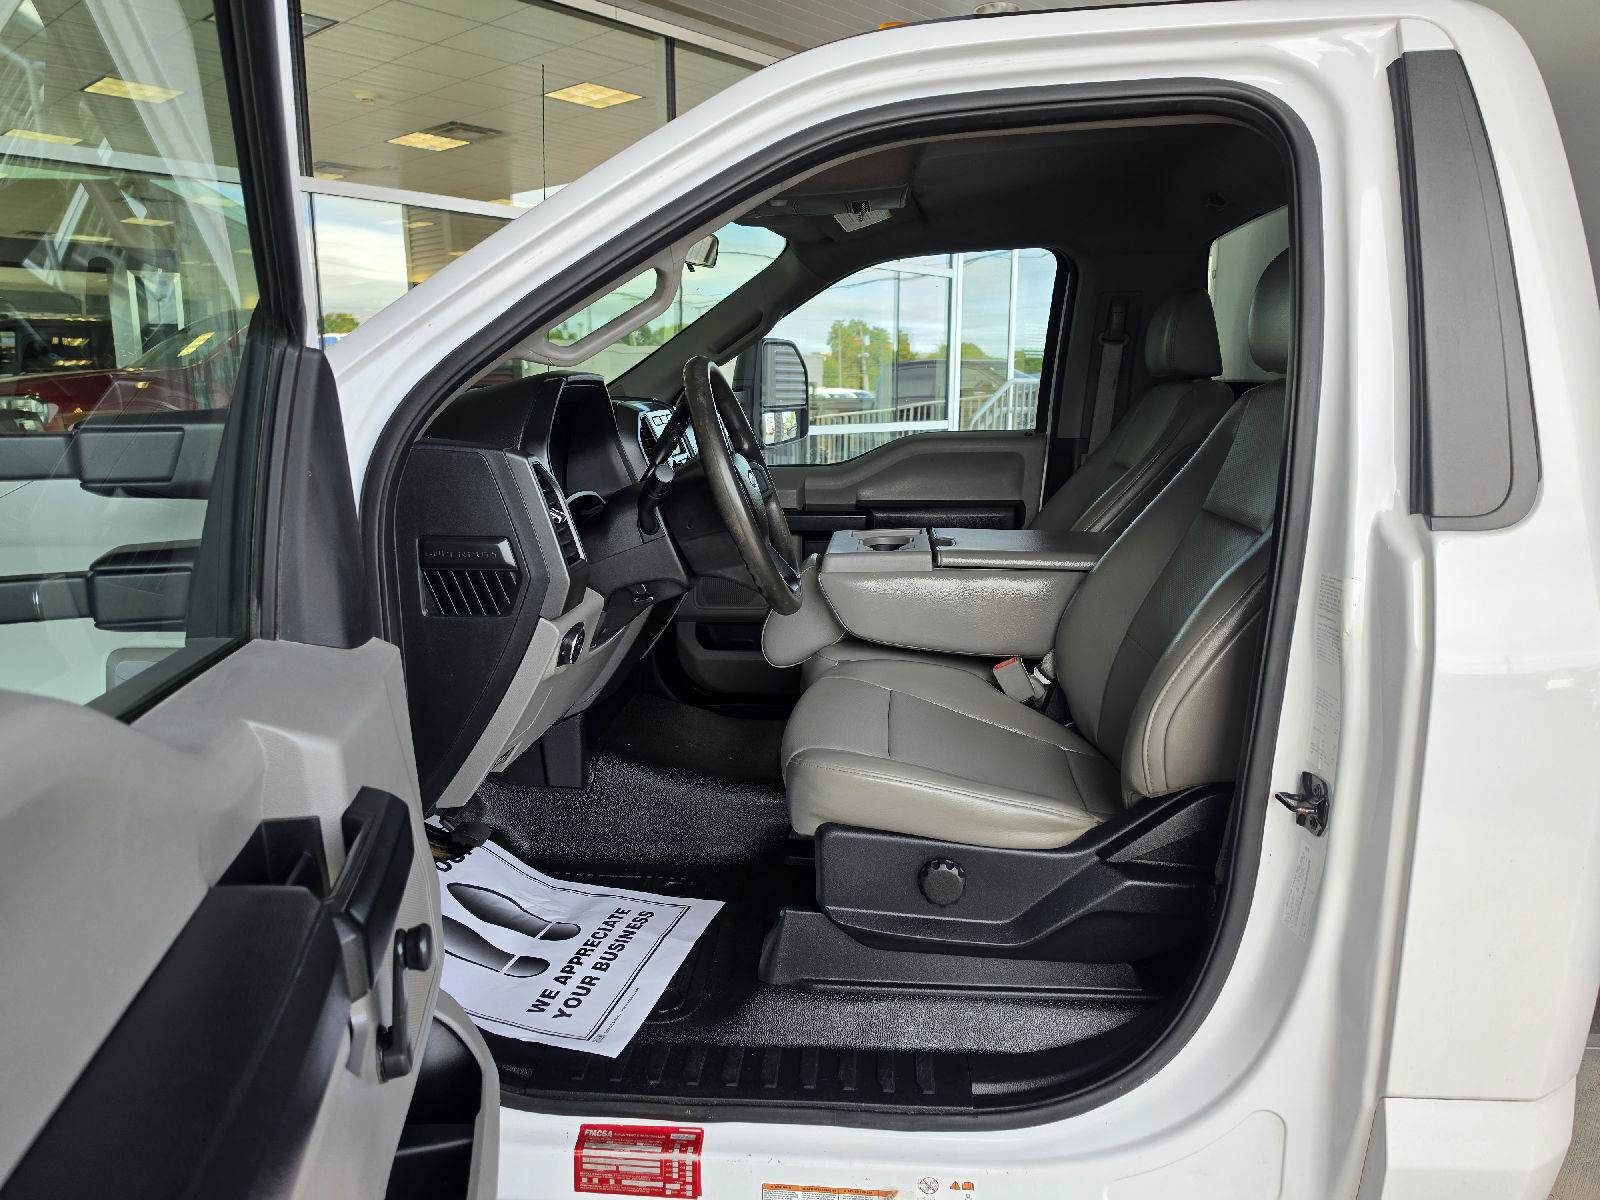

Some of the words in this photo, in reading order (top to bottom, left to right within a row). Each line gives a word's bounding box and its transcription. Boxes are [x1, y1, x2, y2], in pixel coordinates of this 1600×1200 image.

[526, 988, 561, 1013] WE
[553, 907, 631, 986] APPRECIATE
[551, 975, 601, 1019] YOUR
[591, 911, 654, 972] BUSINESS
